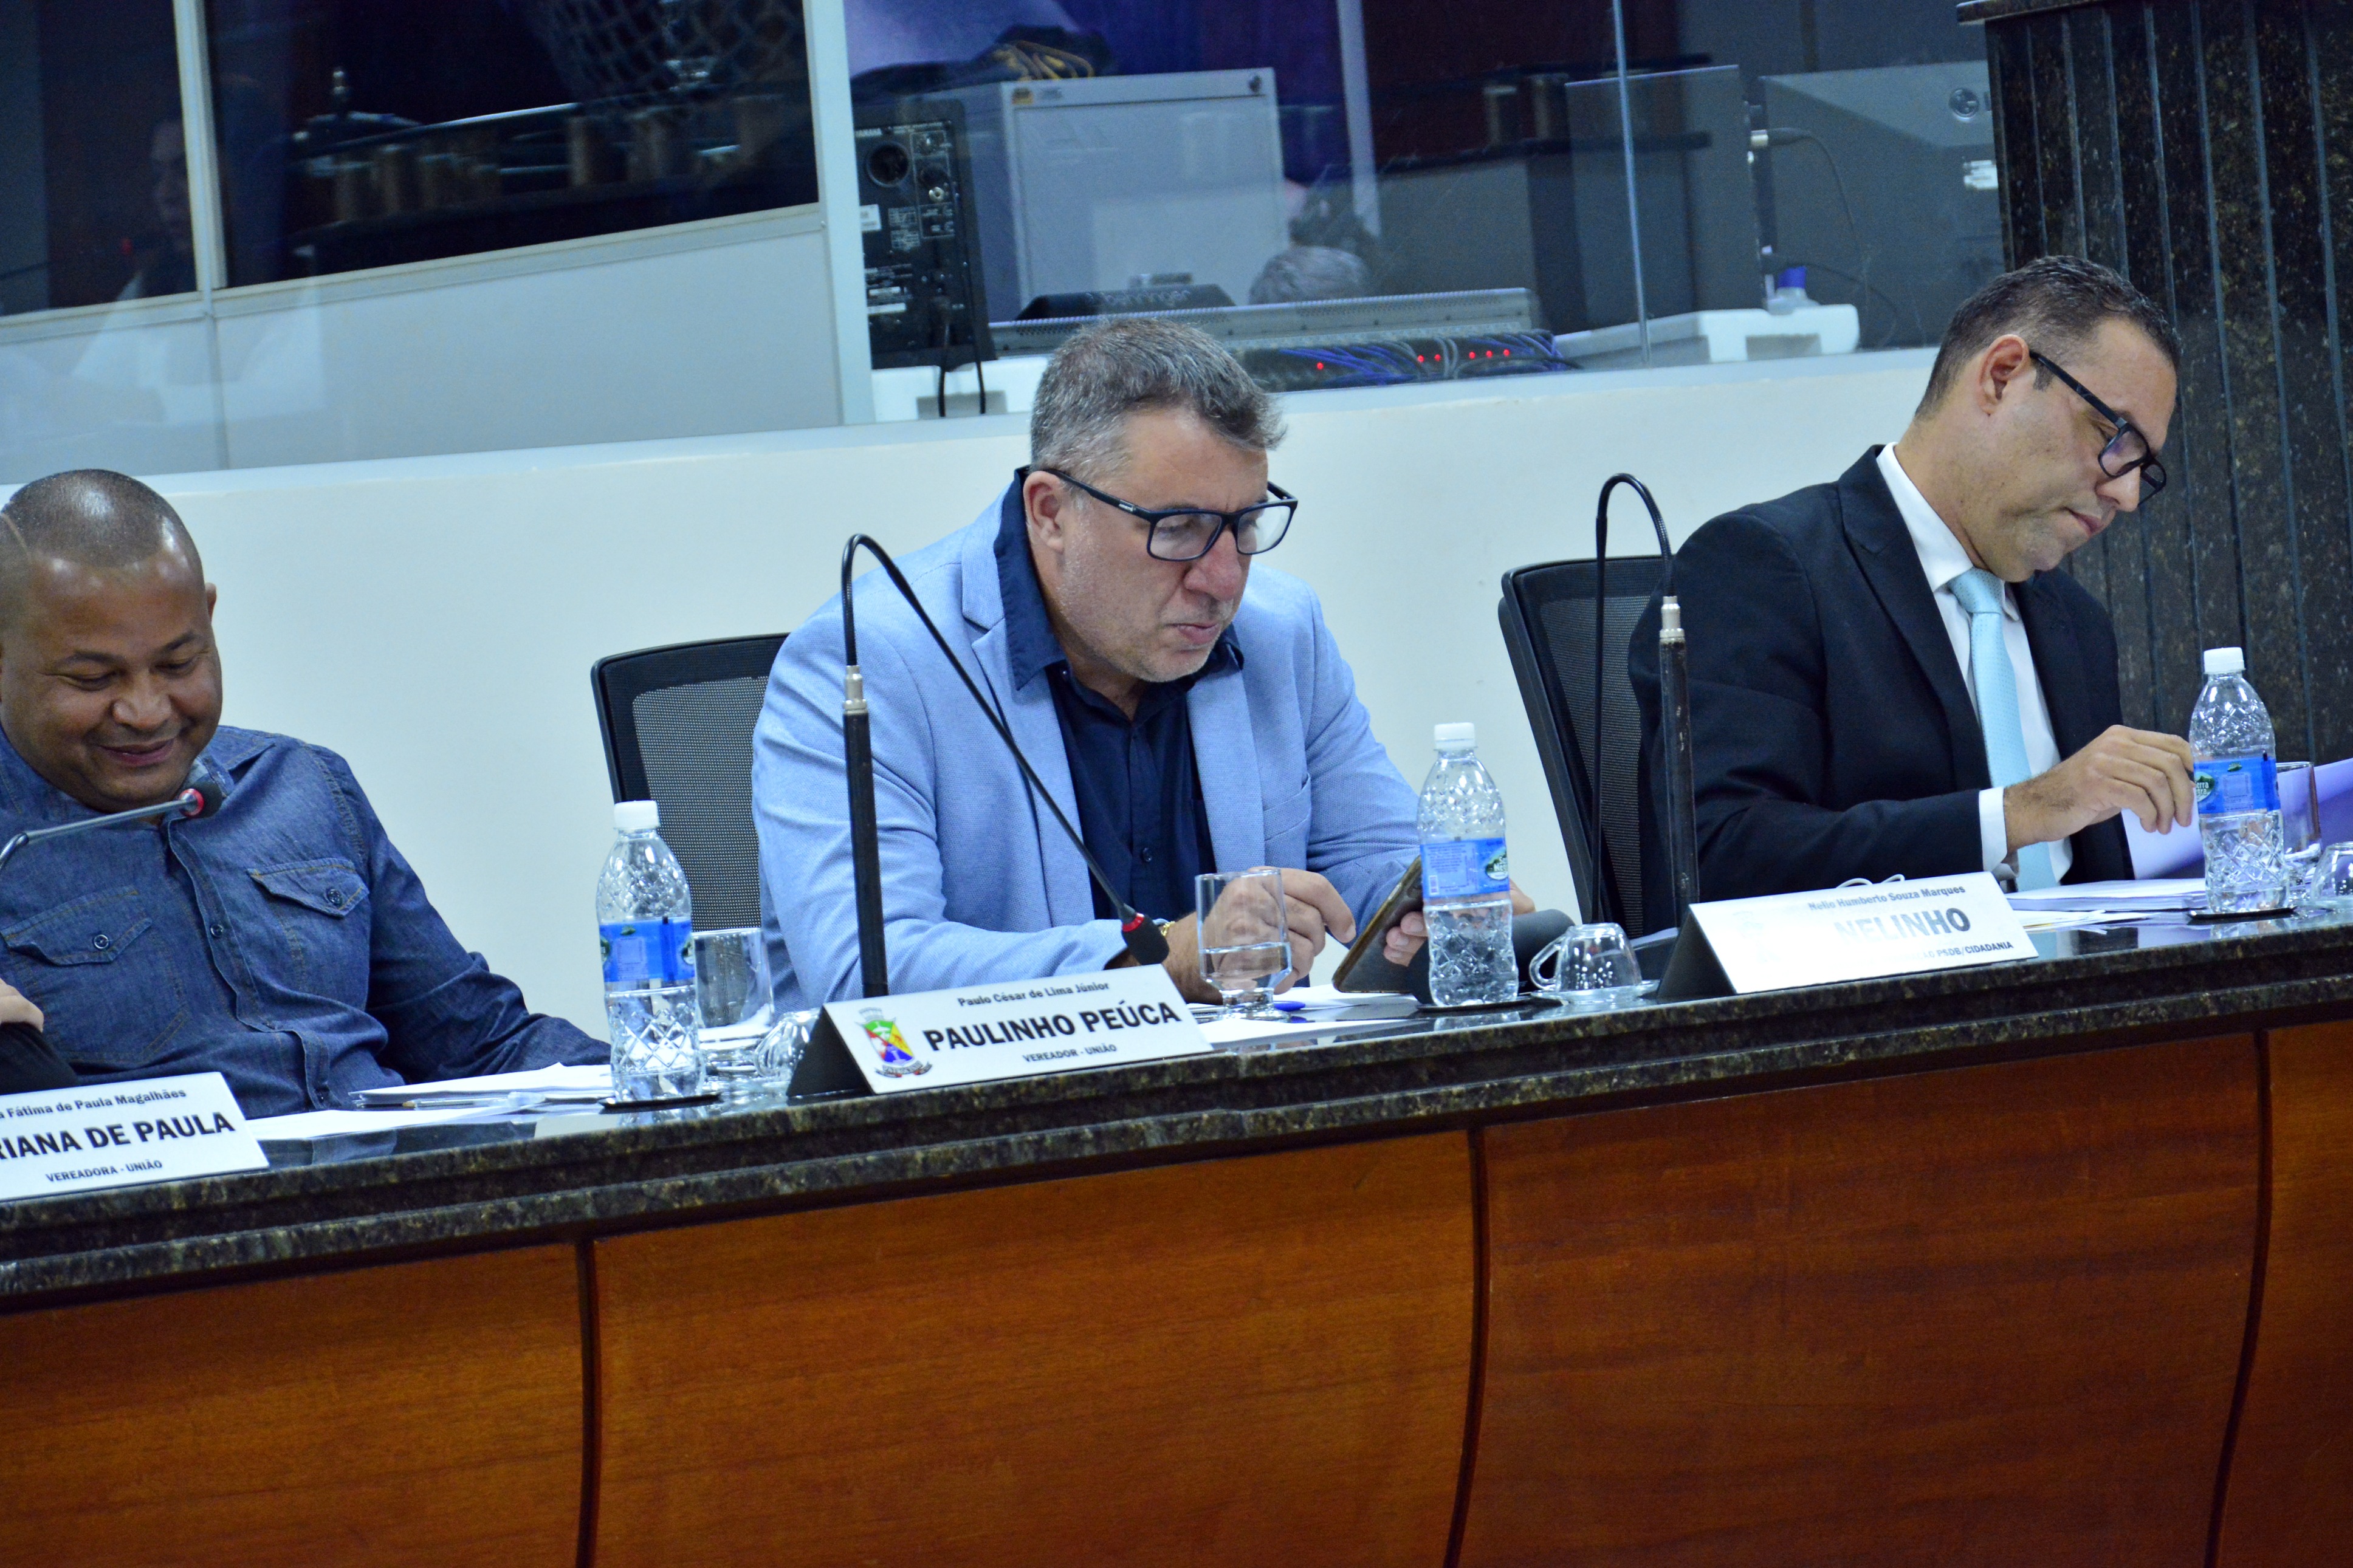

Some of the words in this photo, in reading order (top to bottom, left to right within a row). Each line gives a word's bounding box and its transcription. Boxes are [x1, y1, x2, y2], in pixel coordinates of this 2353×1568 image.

[1836, 894, 1888, 907] Humberto
[1889, 892, 1920, 902] Souza
[1922, 886, 1966, 897] Marques
[1833, 907, 1971, 945] NELINHO
[1936, 941, 2014, 957] PSDB/CIDADANIA
[957, 995, 991, 1007] Paulo
[993, 992, 1026, 1002] César
[1029, 990, 1043, 999] de
[1044, 986, 1073, 996] Lima
[1076, 982, 1110, 993] Júnior
[922, 1013, 1076, 1051] PAULINHO
[1078, 999, 1183, 1033] PEÚCA
[1022, 1049, 1078, 1062] VEREADOR
[1084, 1043, 1117, 1055] UNIÃO
[6, 1105, 53, 1118] Fátima
[56, 1102, 72, 1112] de
[74, 1097, 113, 1109] Paula
[114, 1089, 187, 1104] Magalhães
[83, 1123, 131, 1148] DE
[132, 1111, 236, 1142] PAULA
[46, 1165, 118, 1182] VEREADORA
[125, 1159, 162, 1172] UNIÃO
